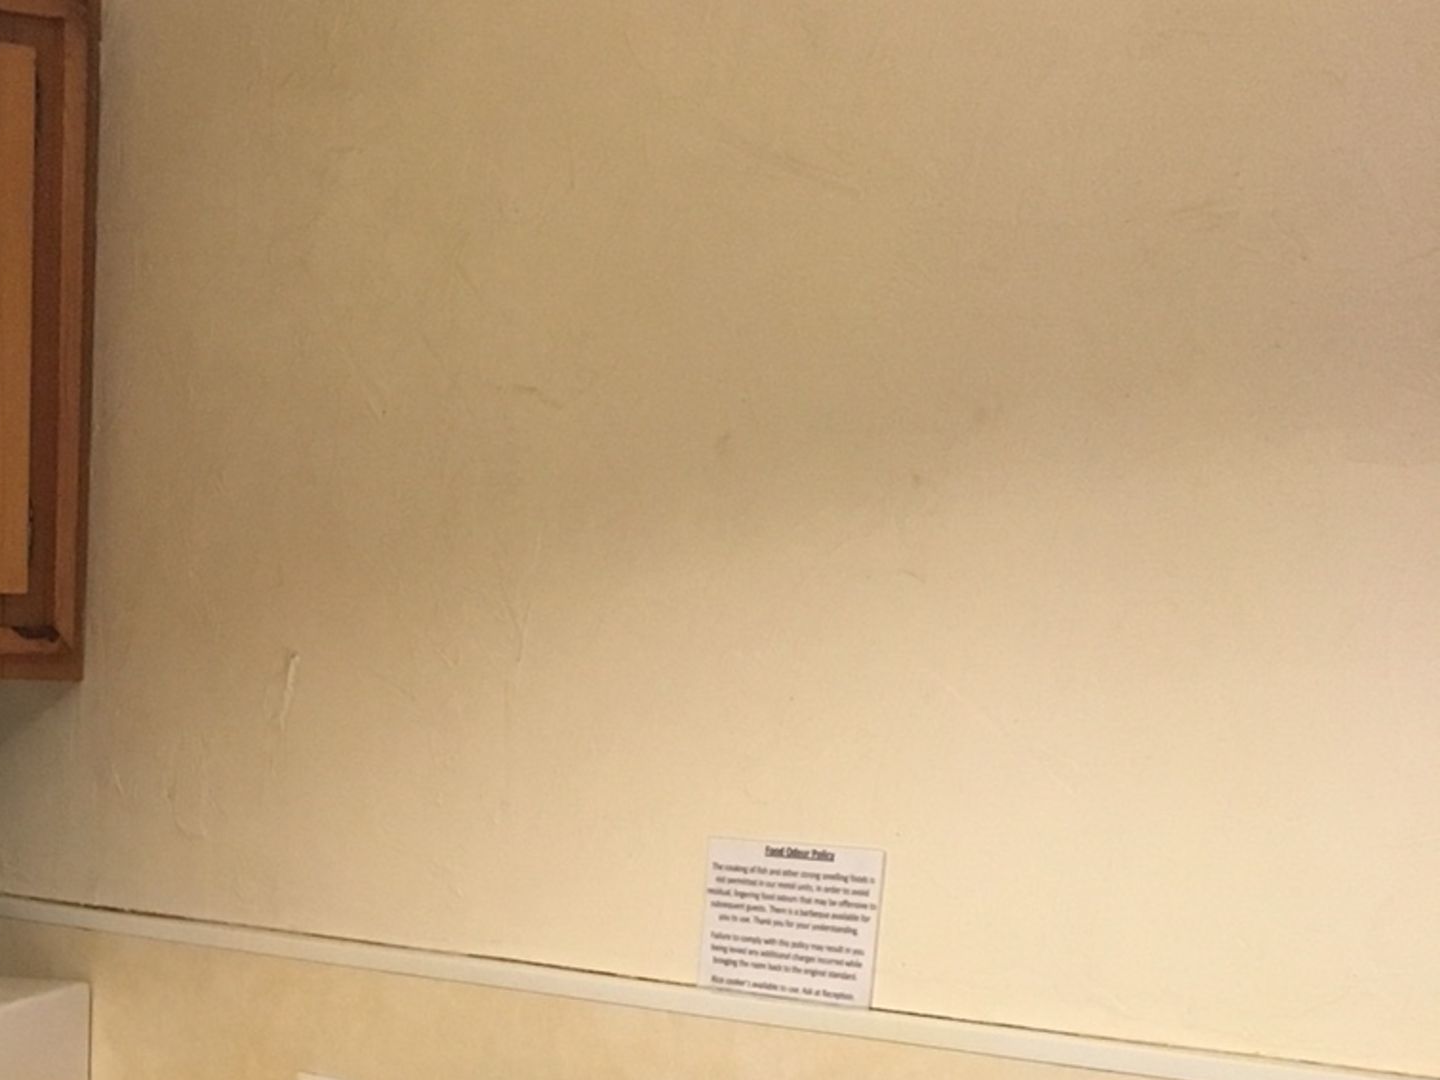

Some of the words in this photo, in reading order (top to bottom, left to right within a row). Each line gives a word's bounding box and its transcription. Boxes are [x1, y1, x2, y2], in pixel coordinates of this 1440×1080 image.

[765, 845, 785, 858] Food
[786, 846, 810, 860] Odour
[812, 849, 835, 862] Policy
